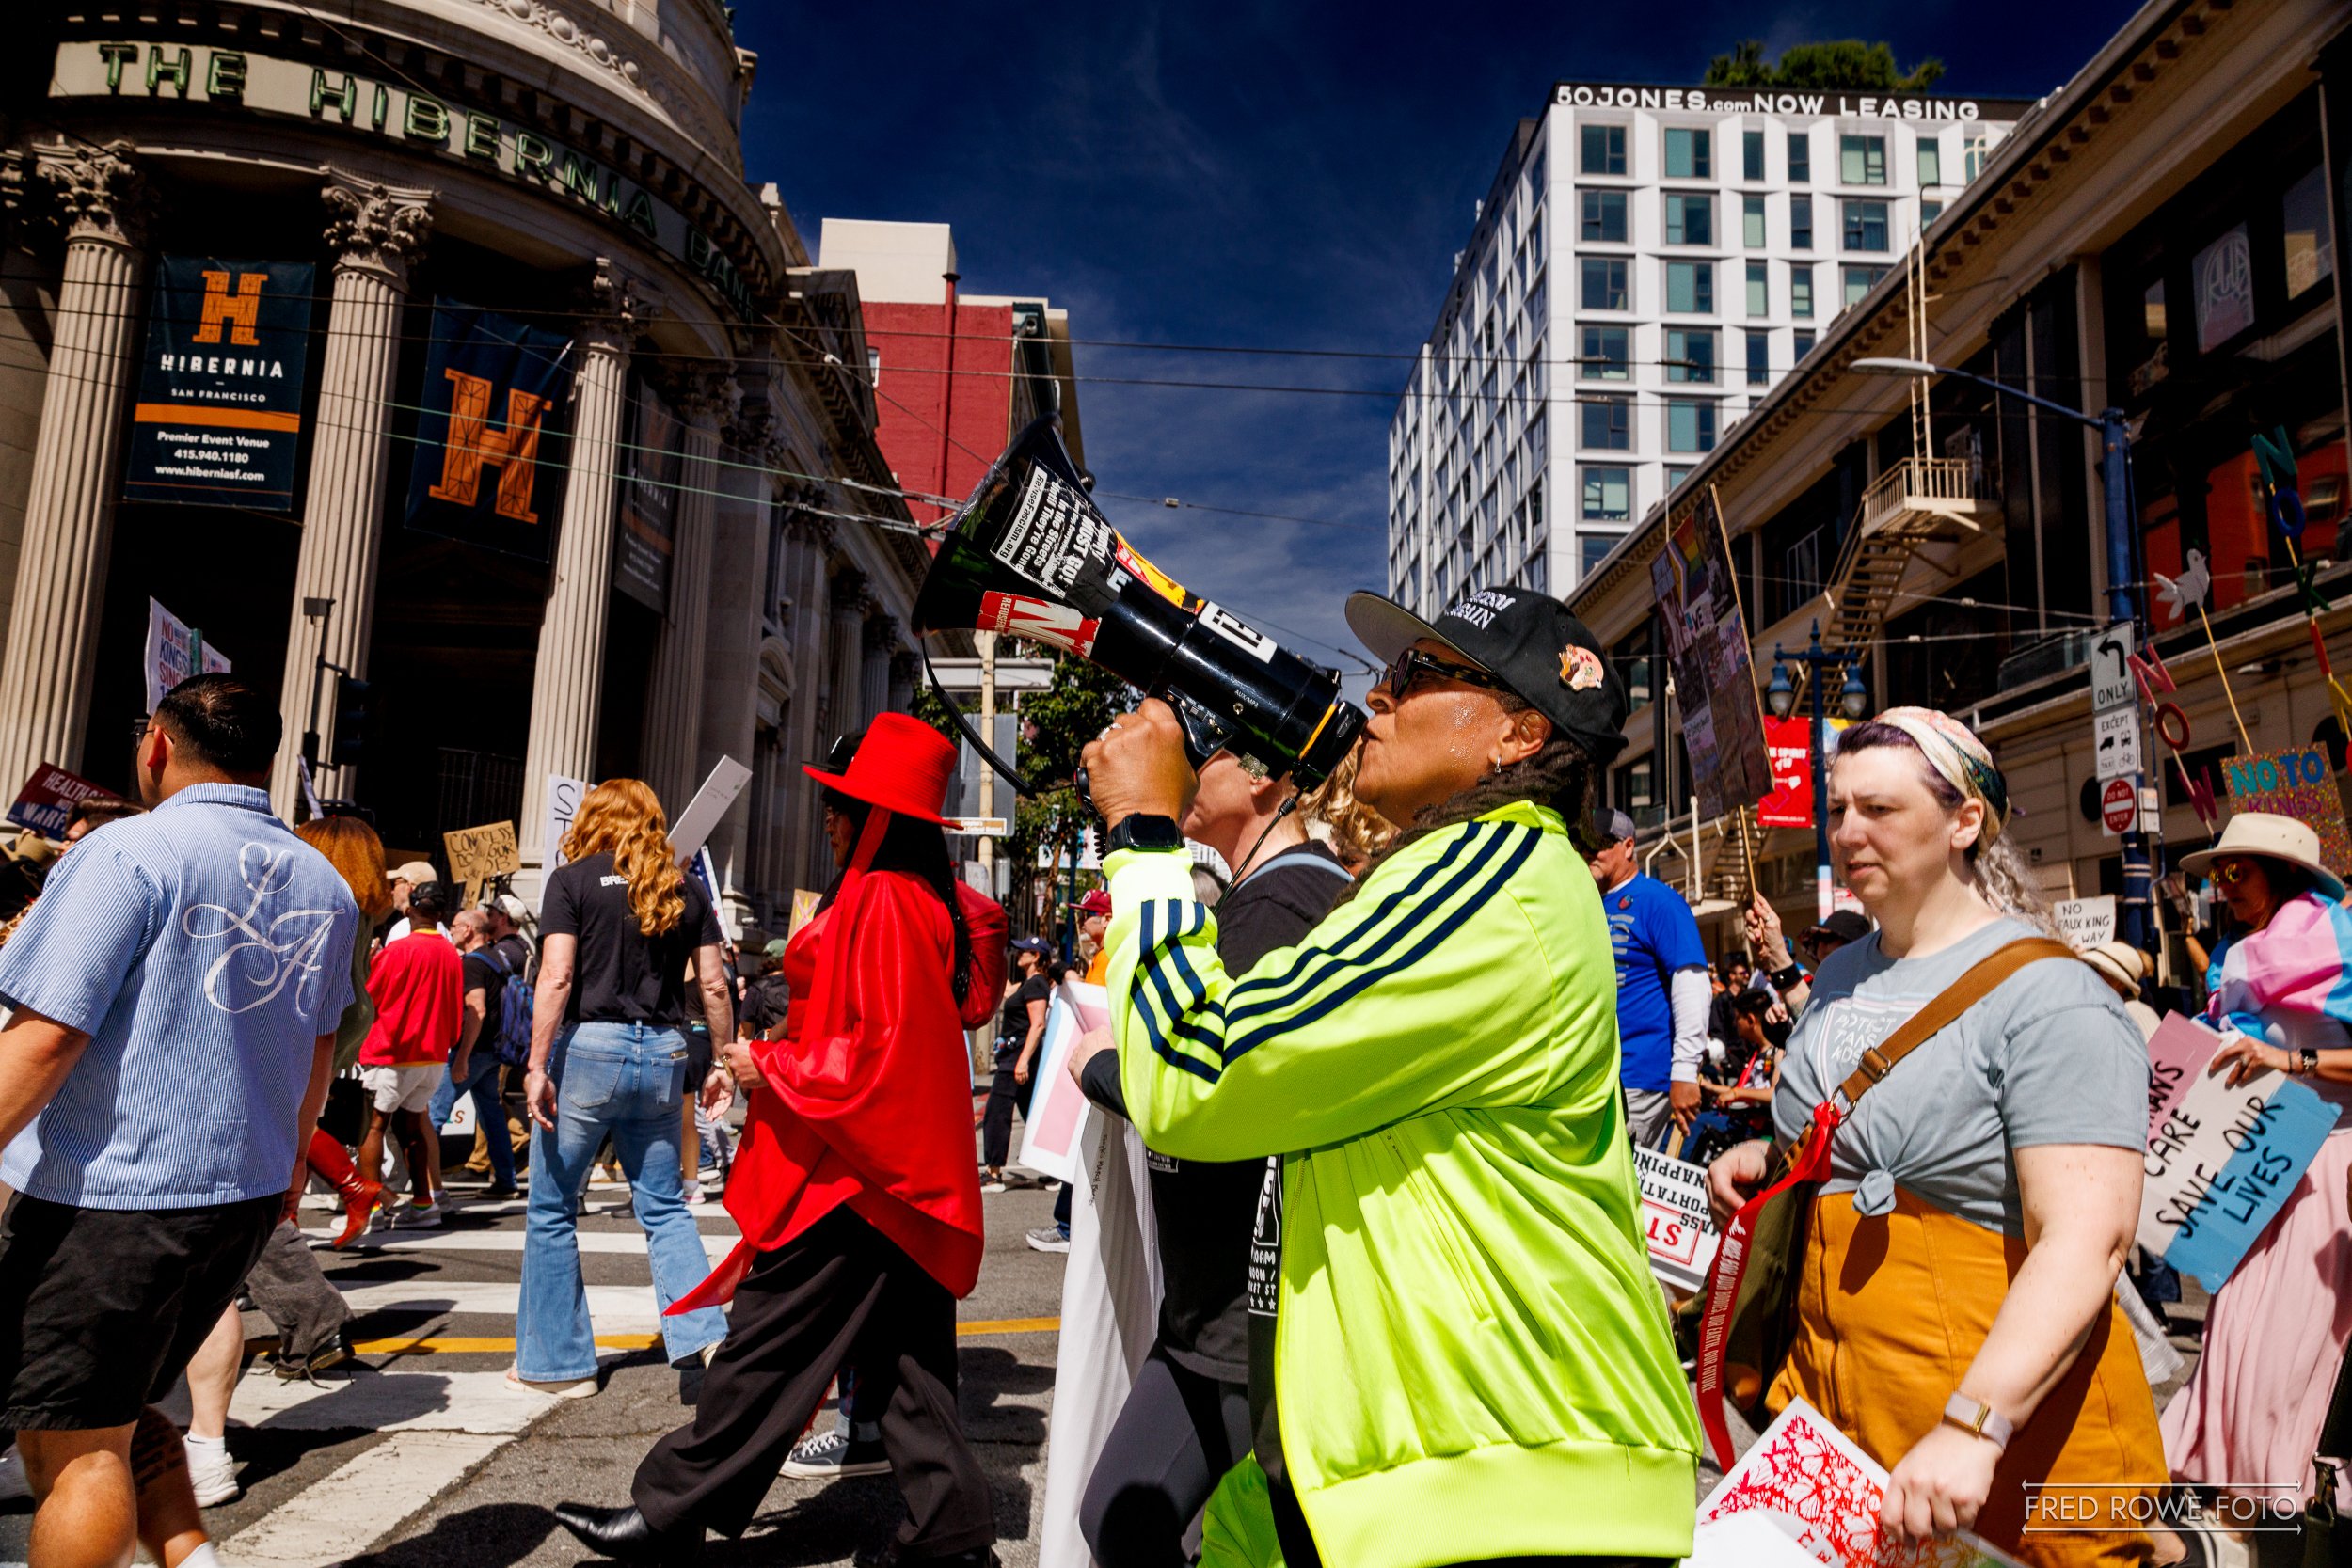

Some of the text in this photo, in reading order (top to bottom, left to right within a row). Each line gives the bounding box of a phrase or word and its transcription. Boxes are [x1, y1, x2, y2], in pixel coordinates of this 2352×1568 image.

[1557, 85, 1979, 121] 50JONES.com NOW LEASING
[98, 43, 247, 95] THE
[310, 67, 659, 238] HIBERNIA
[192, 270, 268, 346] H
[160, 354, 283, 378] HIBERNIA
[170, 388, 266, 403] SAN FRANCISCO
[157, 431, 270, 449] Premier Event Venue
[174, 449, 249, 464] 415.940.1180
[155, 465, 265, 482] www.hiberniasf.com
[999, 474, 1044, 560] RefuseFascism.org
[1030, 506, 1055, 545] They're
[1052, 510, 1066, 531] the
[1016, 544, 1037, 572] Gone
[1033, 529, 1059, 567] Streets
[1058, 514, 1095, 585] MUST GO!
[161, 616, 174, 642] NO
[159, 638, 188, 676] KINGS
[2097, 681, 2129, 705] ONLY
[2101, 714, 2130, 732] EXCEPT
[2230, 752, 2325, 797] NO TO
[2106, 787, 2129, 800] DO NOT
[2248, 790, 2323, 816] KINGS
[2109, 812, 2129, 824] ENTER
[2062, 903, 2082, 916] NO
[2085, 915, 2110, 928] KING
[2081, 930, 2106, 943] WAY
[2144, 1108, 2201, 1177] CARE
[2155, 1096, 2285, 1239] SAVE OUR
[2223, 1146, 2293, 1225] LIVES
[1264, 1283, 1277, 1296] ST
[1716, 1272, 1738, 1291] OUR
[1708, 1313, 1725, 1330] OUR
[1704, 1325, 1724, 1353] EARTH,
[1703, 1349, 1721, 1368] OUR
[1701, 1364, 1718, 1394] FUTURE
